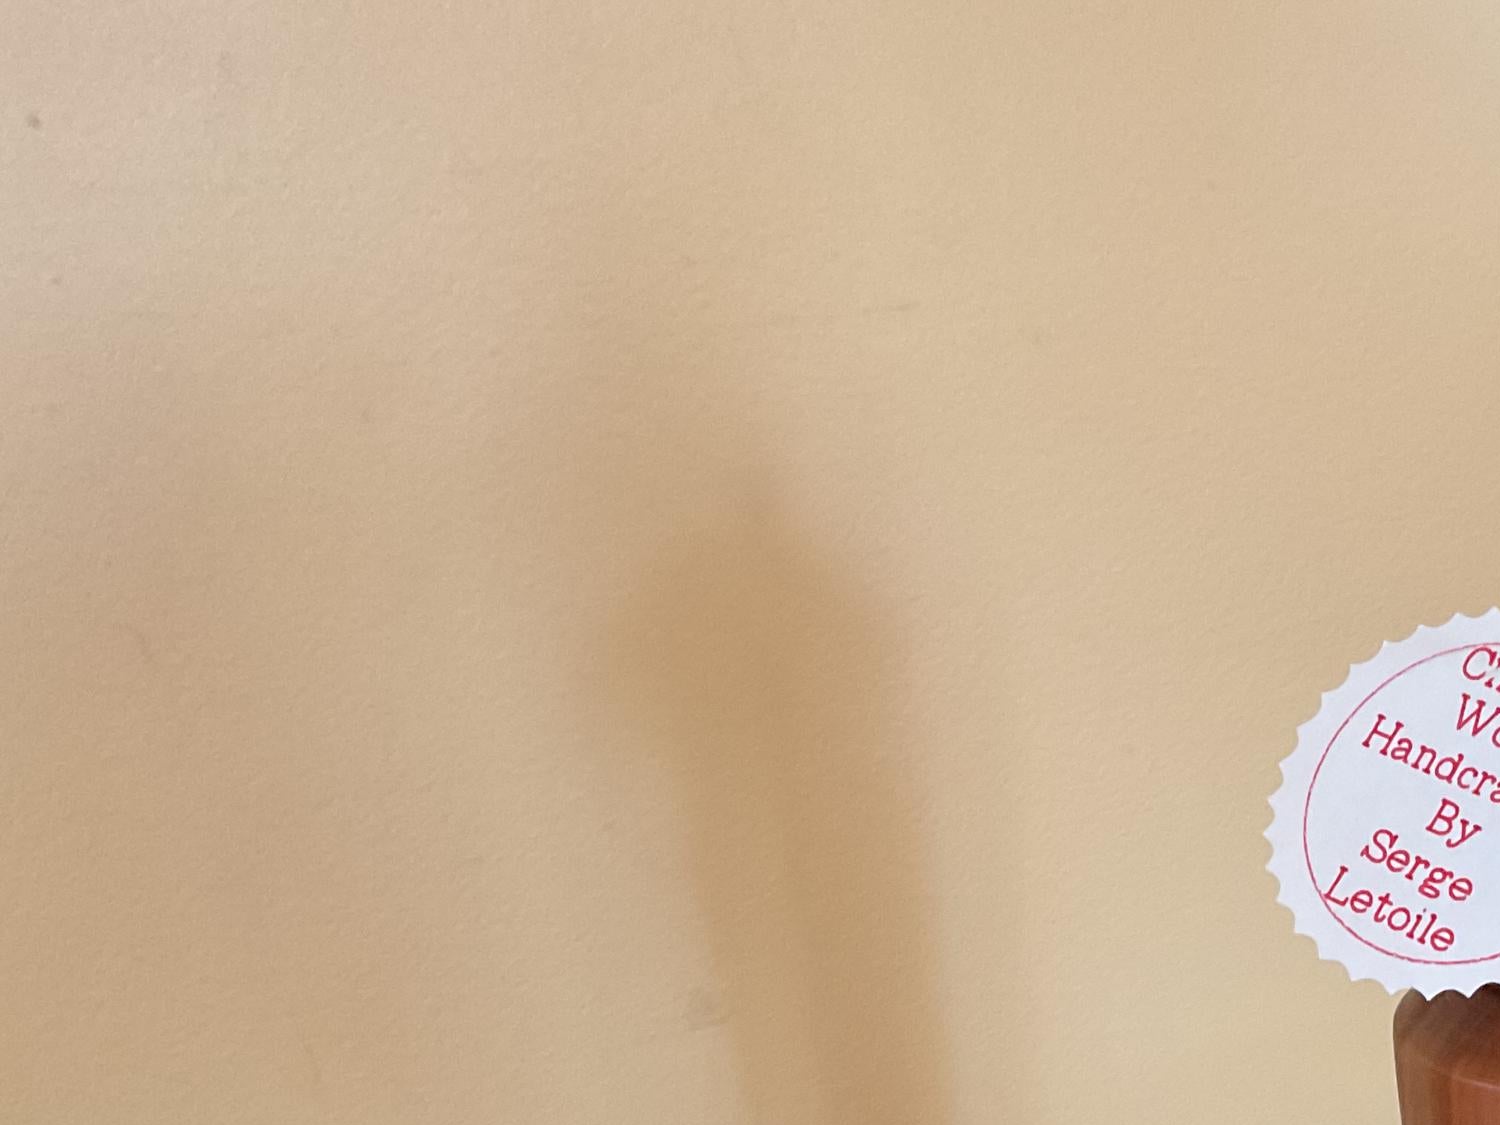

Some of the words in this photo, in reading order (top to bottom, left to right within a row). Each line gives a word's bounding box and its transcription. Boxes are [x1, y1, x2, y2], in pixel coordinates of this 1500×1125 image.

[1425, 798, 1482, 848] By
[1360, 829, 1474, 902] Serge
[1324, 865, 1455, 952] Letoile
